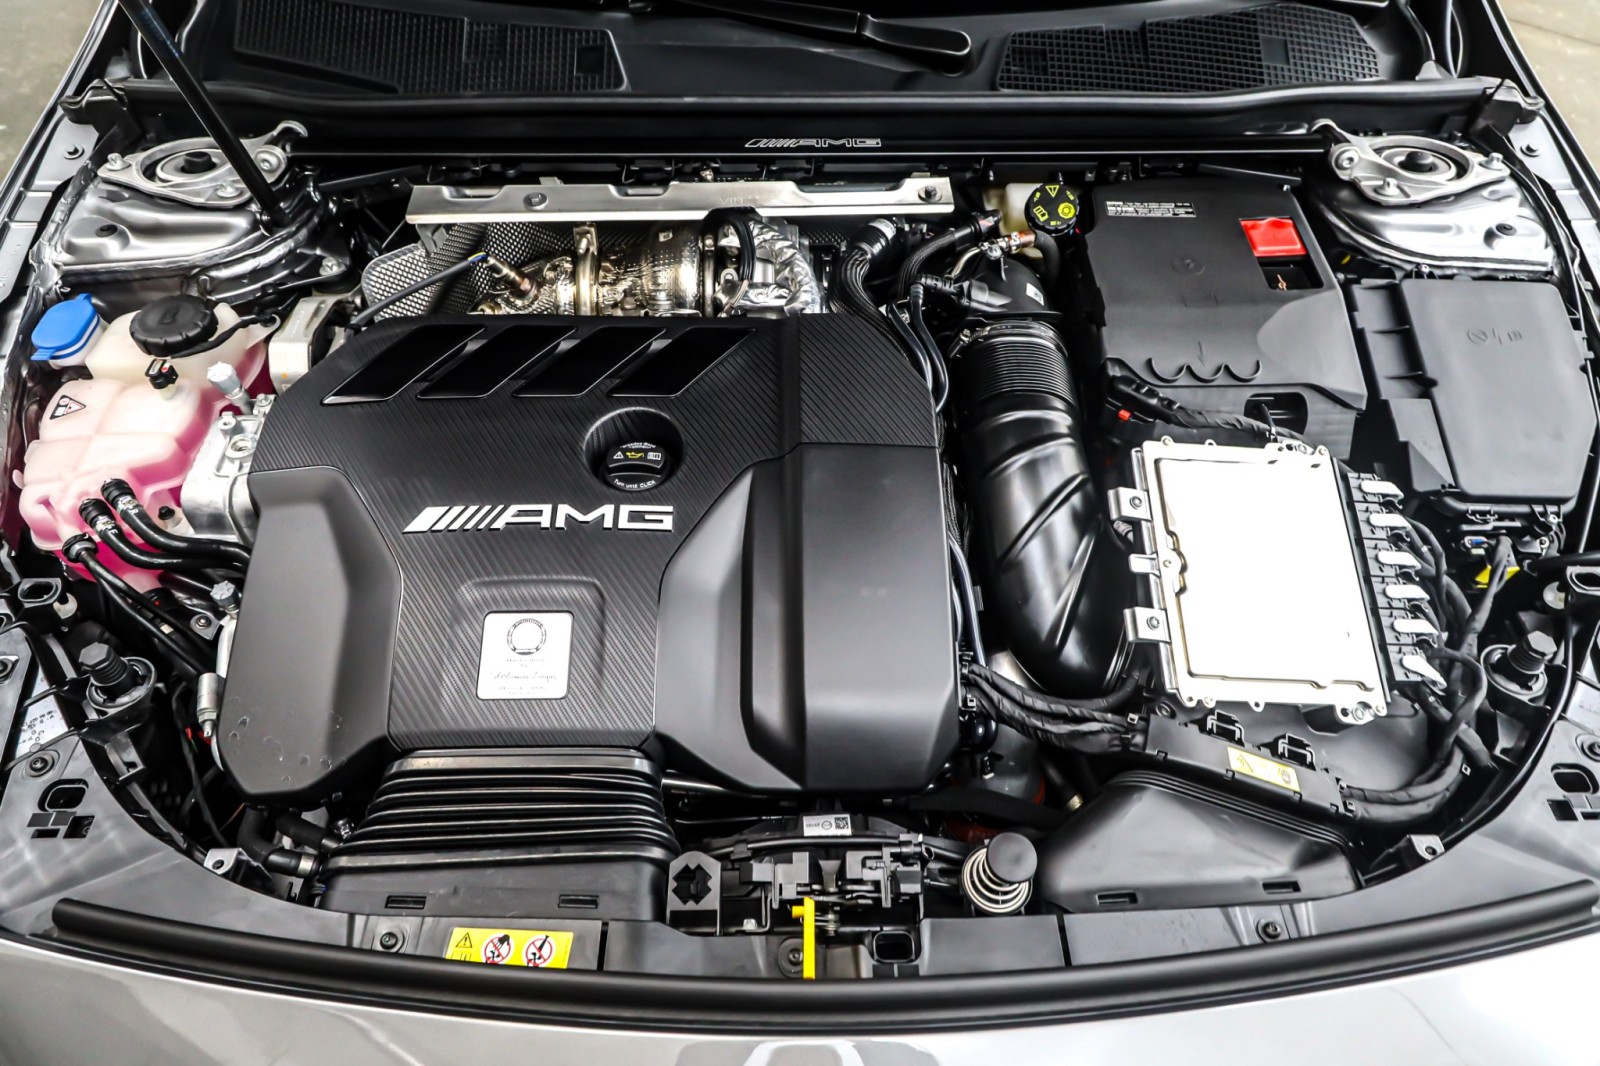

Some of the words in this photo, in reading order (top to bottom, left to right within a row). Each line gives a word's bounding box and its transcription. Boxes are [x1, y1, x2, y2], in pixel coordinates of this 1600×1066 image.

[791, 138, 882, 147] AMG
[640, 480, 656, 488] CLICK
[489, 504, 674, 532] AMG
